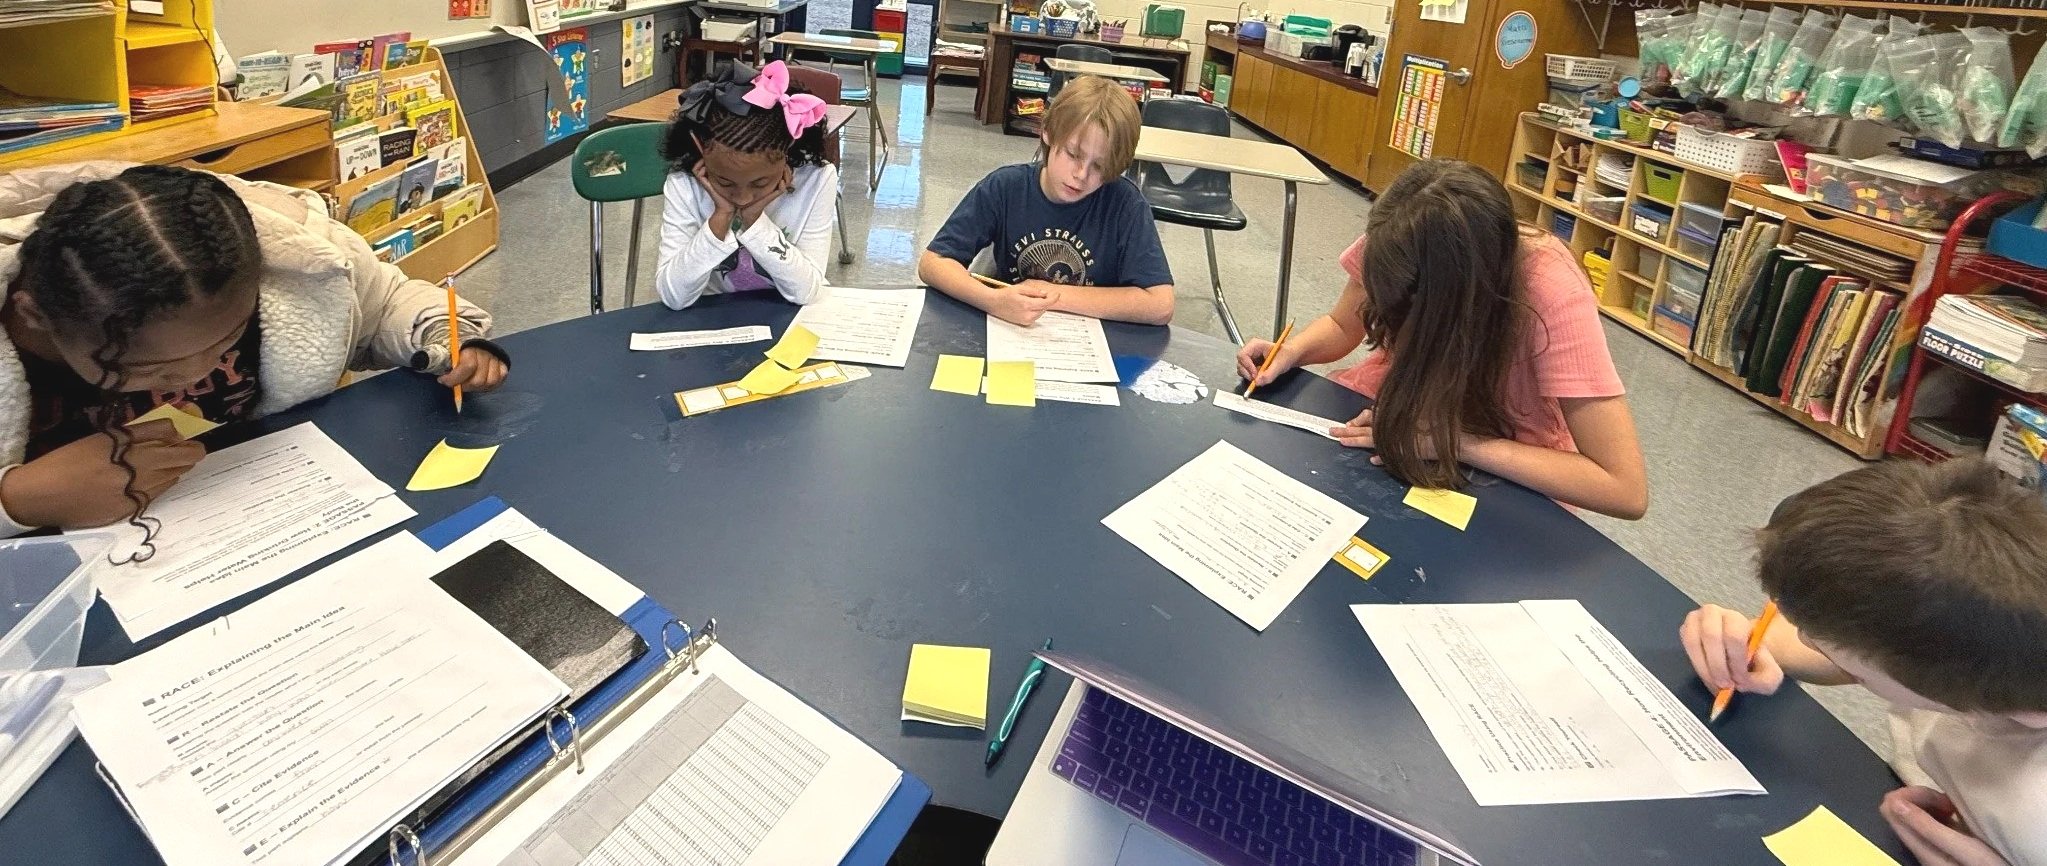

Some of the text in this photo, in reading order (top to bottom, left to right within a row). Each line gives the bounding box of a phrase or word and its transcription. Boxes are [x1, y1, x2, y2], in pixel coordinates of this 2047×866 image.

[552, 36, 557, 47] 5
[1407, 56, 1444, 69] Multiplication
[383, 138, 412, 151] RACING
[394, 147, 410, 156] RAIN
[1010, 228, 1095, 266] LEVI STRAUSS
[1922, 336, 1984, 369] FLOOR PUZZLE
[323, 501, 365, 523] PASSAGE
[278, 529, 328, 554] Explaining
[289, 527, 310, 539] How
[246, 537, 288, 560] Drinking
[261, 551, 277, 562] the
[216, 557, 246, 574] Water
[233, 559, 258, 574] Main
[182, 572, 214, 590] Helps
[1573, 634, 1586, 643] the
[159, 605, 346, 699] RACE: Explaining the Main Idea
[1583, 645, 1603, 662] Helps
[1602, 663, 1635, 695] Recycling
[199, 704, 240, 726] Restate
[239, 694, 256, 705] the
[256, 672, 299, 696] Question
[1632, 697, 1651, 712] How
[205, 698, 325, 768] A Answer the Question
[1467, 703, 1514, 762] Practice Using RACE
[1655, 723, 1696, 761] PASSAGE
[1657, 713, 1707, 760] Environment
[230, 749, 321, 806] C Cite Evidence
[258, 764, 382, 846] E Explain the Evidence
